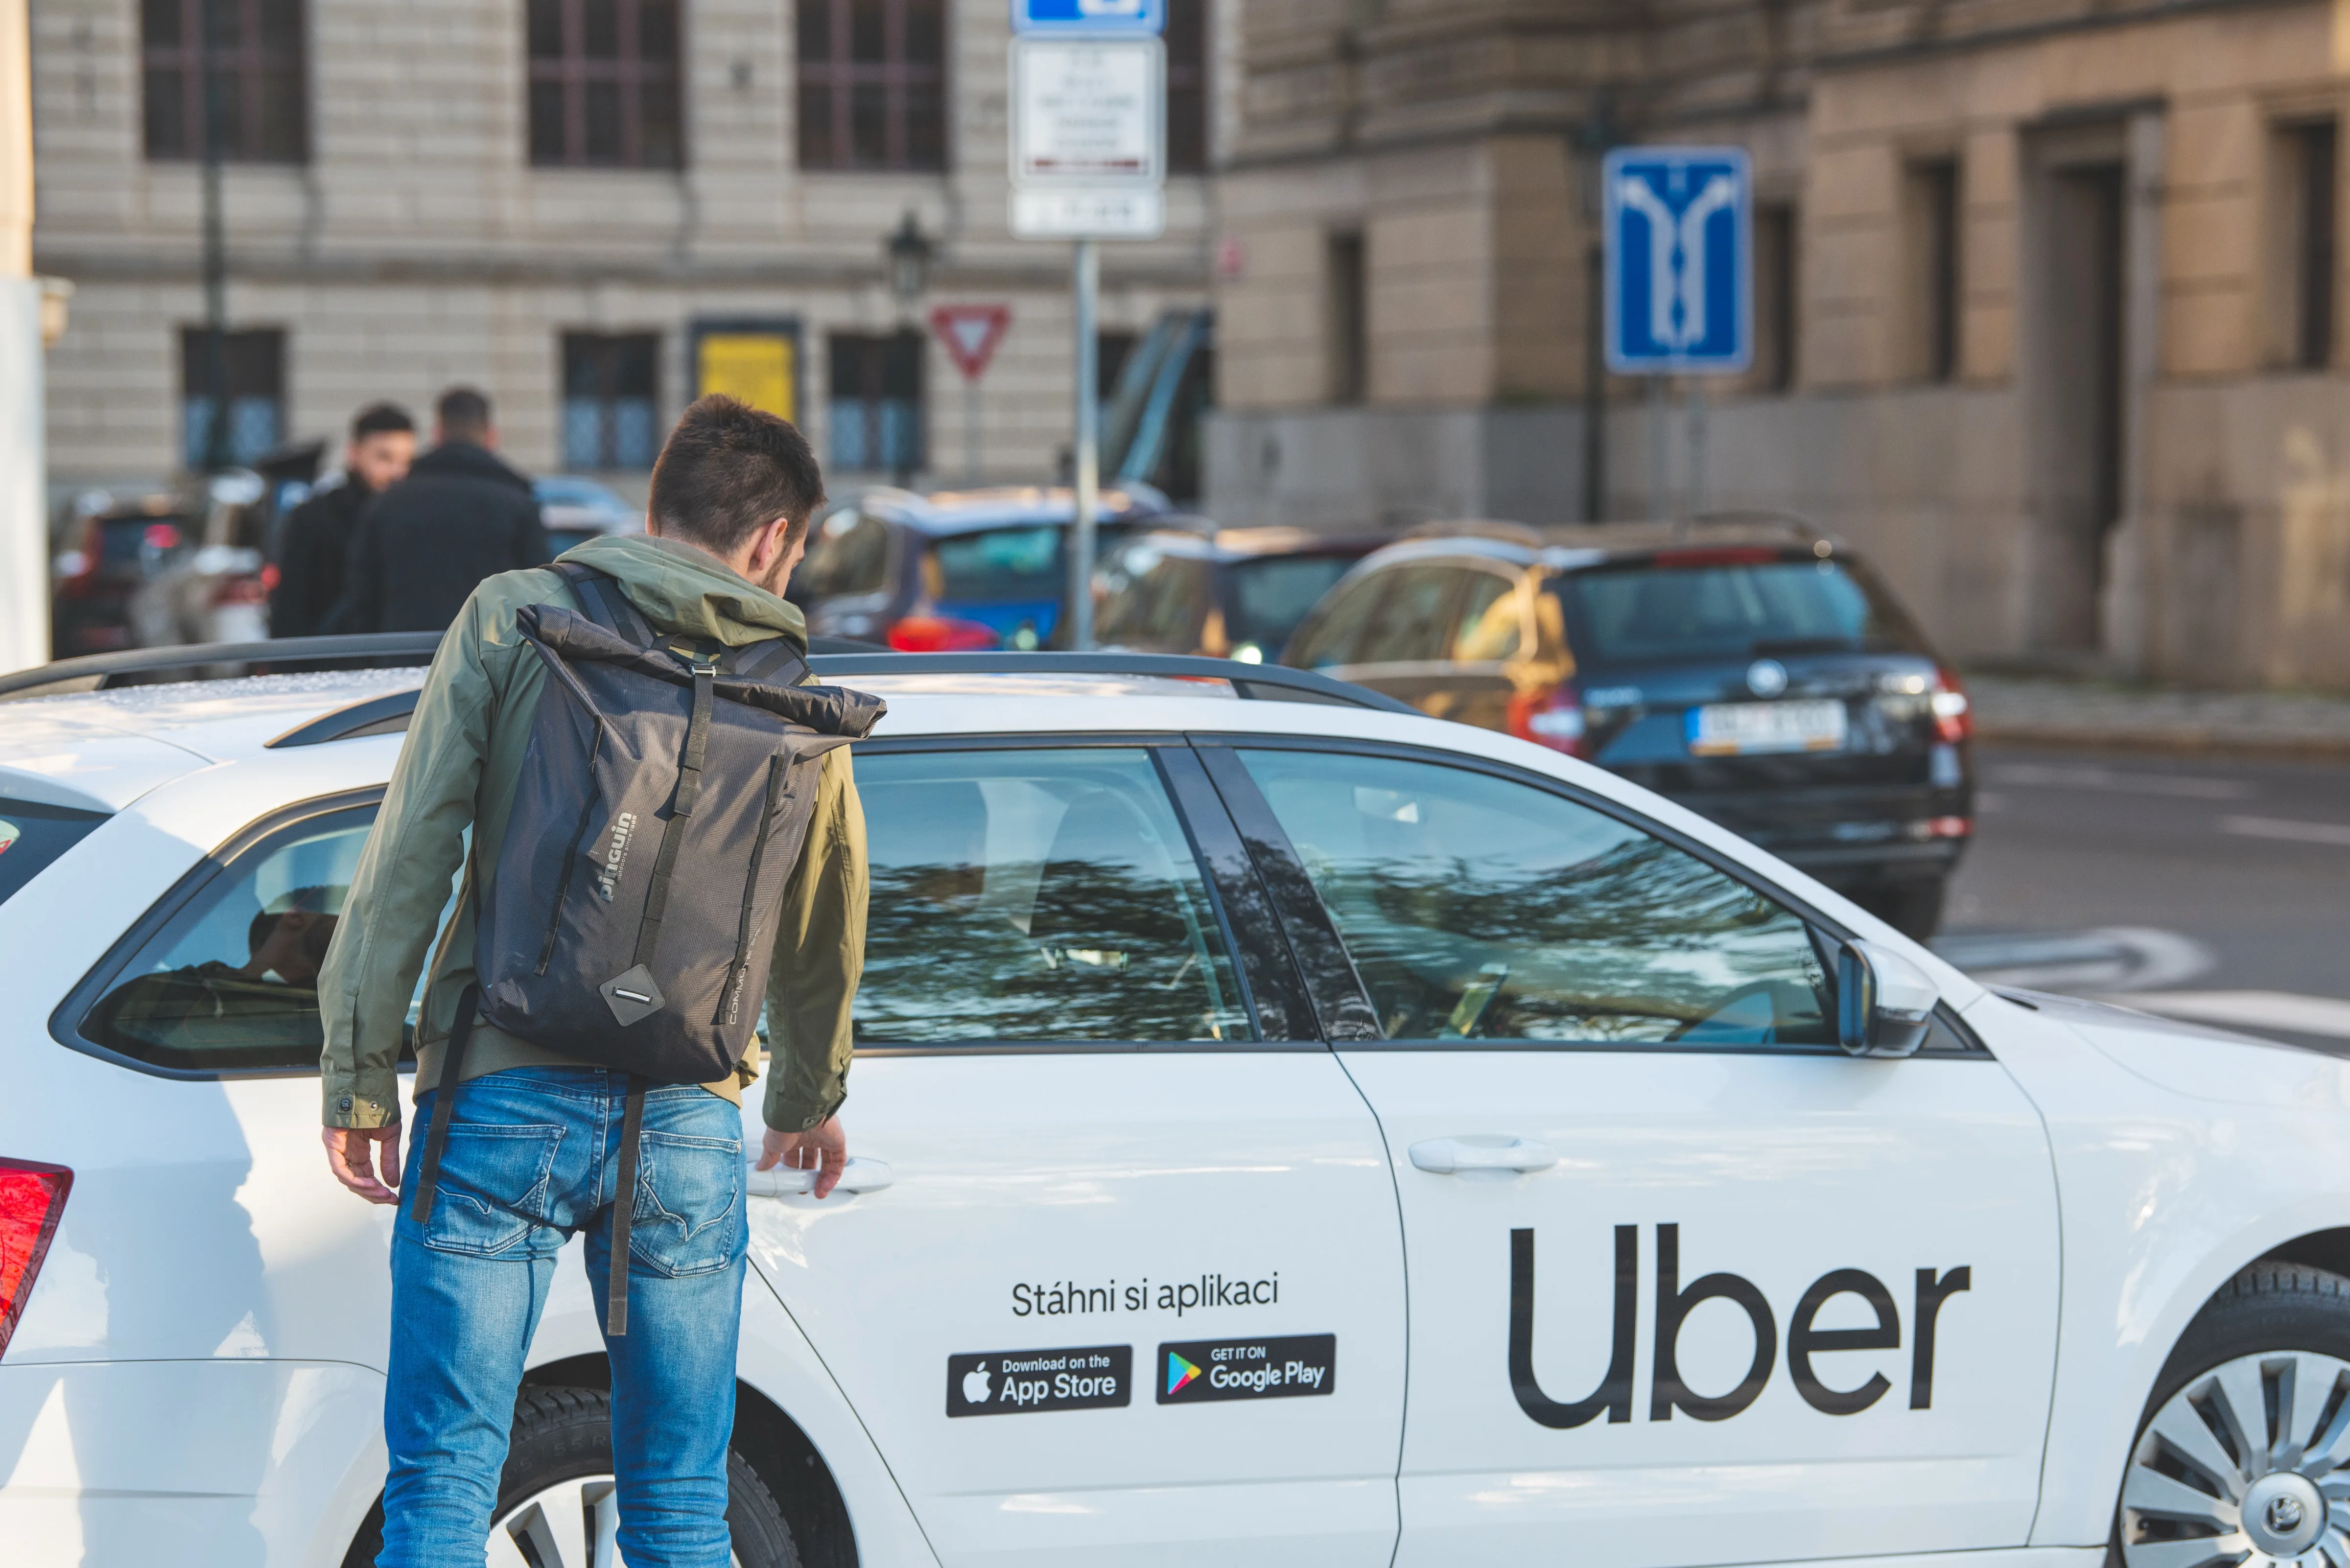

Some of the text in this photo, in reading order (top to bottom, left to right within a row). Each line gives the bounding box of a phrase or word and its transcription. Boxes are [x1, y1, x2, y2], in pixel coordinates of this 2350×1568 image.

[618, 853, 627, 880] outdoors
[730, 950, 752, 1025] COMMUTE
[1012, 1272, 1278, 1317] Stáhni si aplikaci
[1508, 1222, 1971, 1429] Uber
[1003, 1354, 1110, 1373] Download on the
[1211, 1346, 1266, 1361] GET IT ON
[1000, 1373, 1116, 1405] App Store
[1210, 1360, 1325, 1392] Google Play
